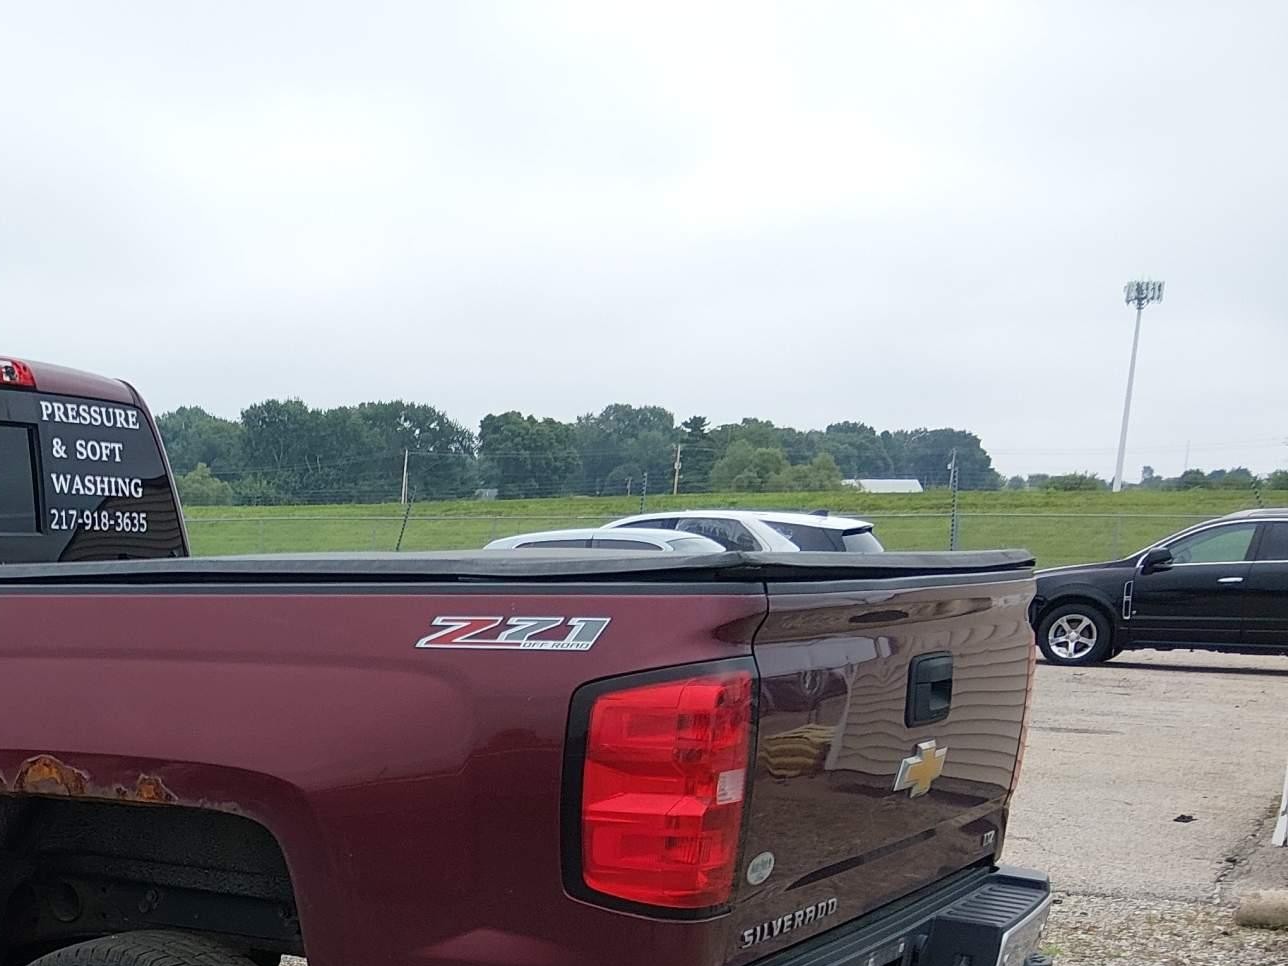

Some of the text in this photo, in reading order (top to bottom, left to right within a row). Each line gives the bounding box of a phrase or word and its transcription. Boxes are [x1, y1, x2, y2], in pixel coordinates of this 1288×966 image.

[40, 400, 140, 430] PRESSURE
[52, 437, 123, 462] & SOFT
[50, 473, 144, 498] WASHING
[50, 508, 148, 533] 217-918-3635
[415, 616, 612, 651] Z71
[522, 641, 590, 650] OFF ROAD
[741, 897, 838, 949] SILVERADO
